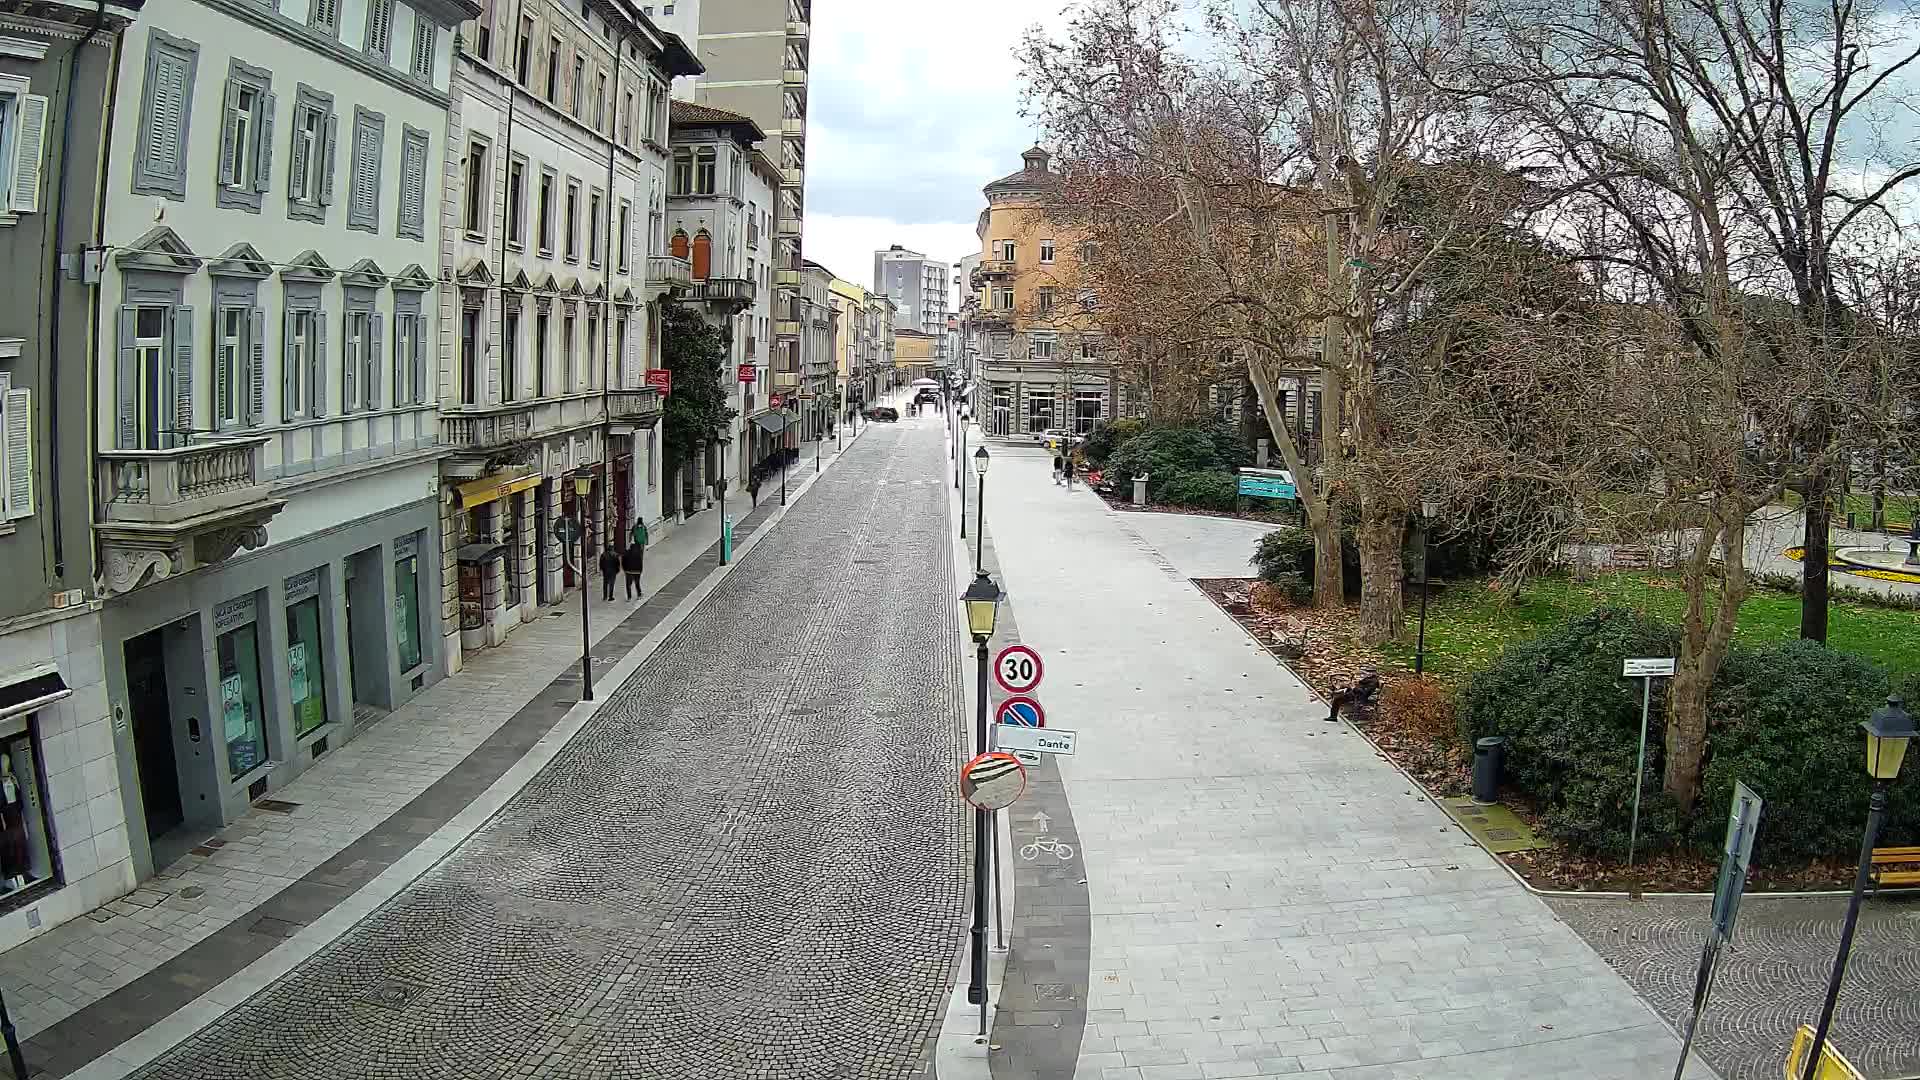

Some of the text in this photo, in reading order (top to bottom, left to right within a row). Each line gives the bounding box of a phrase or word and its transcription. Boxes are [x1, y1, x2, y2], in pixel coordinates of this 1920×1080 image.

[233, 597, 254, 612] CREDITO
[1005, 658, 1033, 681] 30
[1038, 738, 1070, 750] Dante
